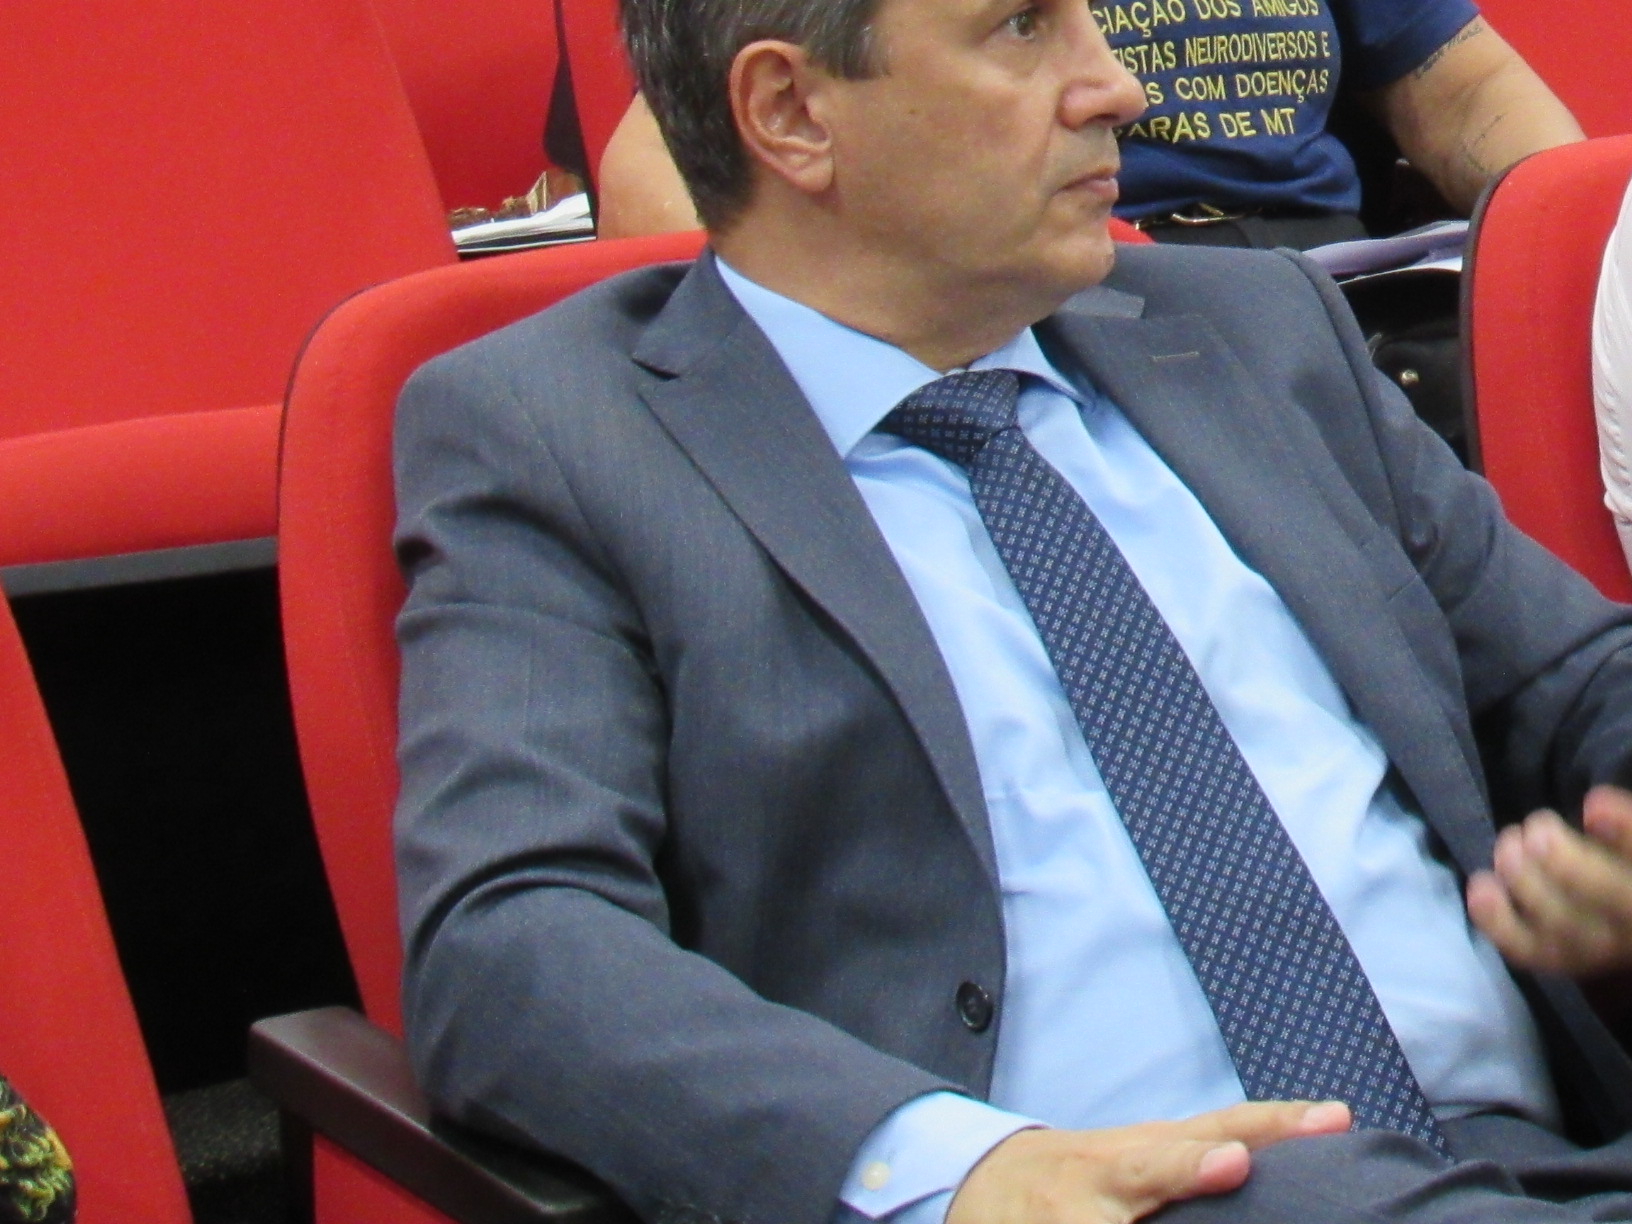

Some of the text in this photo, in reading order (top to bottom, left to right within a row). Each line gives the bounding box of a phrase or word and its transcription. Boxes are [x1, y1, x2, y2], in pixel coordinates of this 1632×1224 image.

[1185, 31, 1318, 68] NEURODIVERSOS
[1321, 31, 1331, 58] E
[1175, 74, 1227, 102] COM
[1236, 68, 1329, 104] DOENÇAS
[1117, 108, 1296, 144] ARAS DE MT
